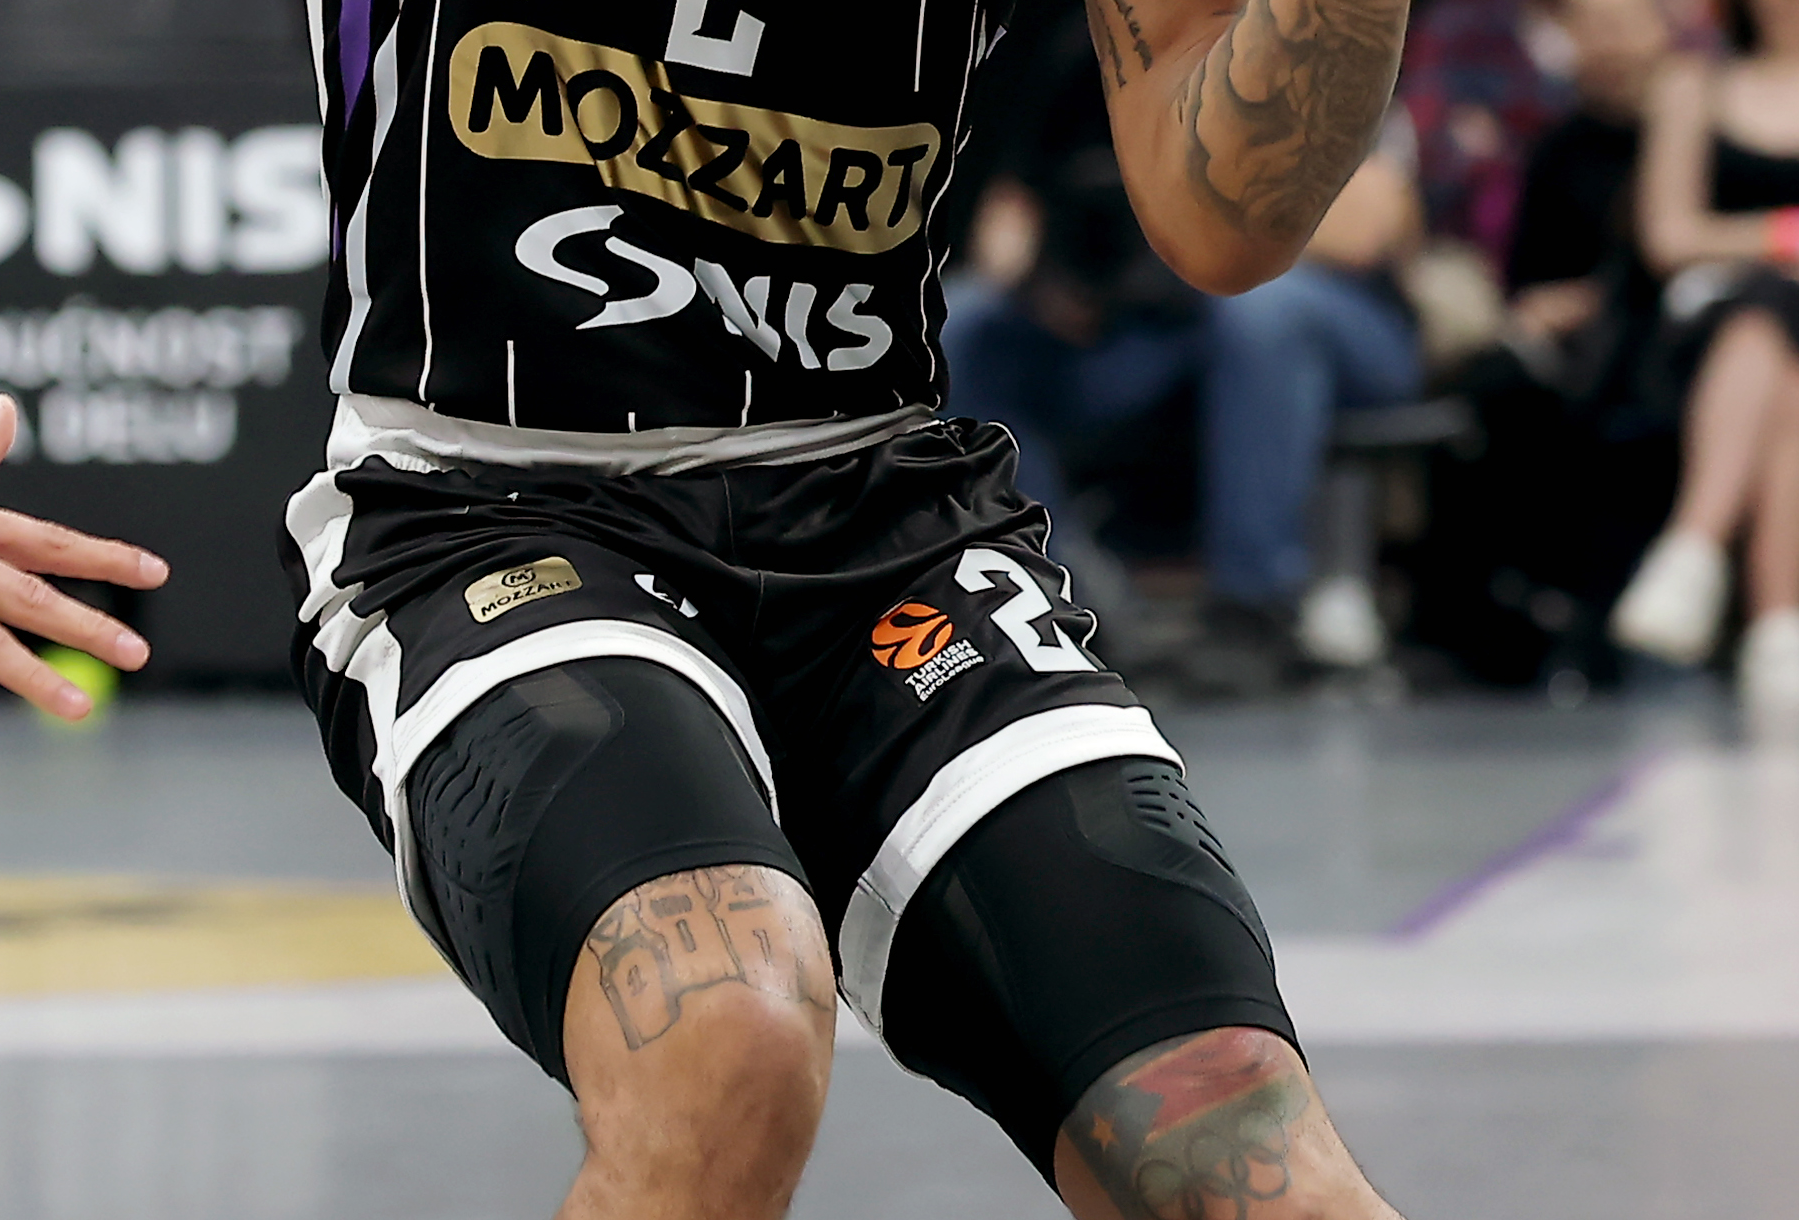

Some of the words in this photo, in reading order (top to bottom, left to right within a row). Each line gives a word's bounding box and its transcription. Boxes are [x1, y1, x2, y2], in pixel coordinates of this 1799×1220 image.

[467, 44, 930, 232] MOZZART
[32, 125, 332, 275] NIS
[694, 257, 893, 372] NIS
[904, 638, 972, 686] TURKISH
[954, 548, 1099, 672] 2
[914, 647, 979, 696] AIRLINES
